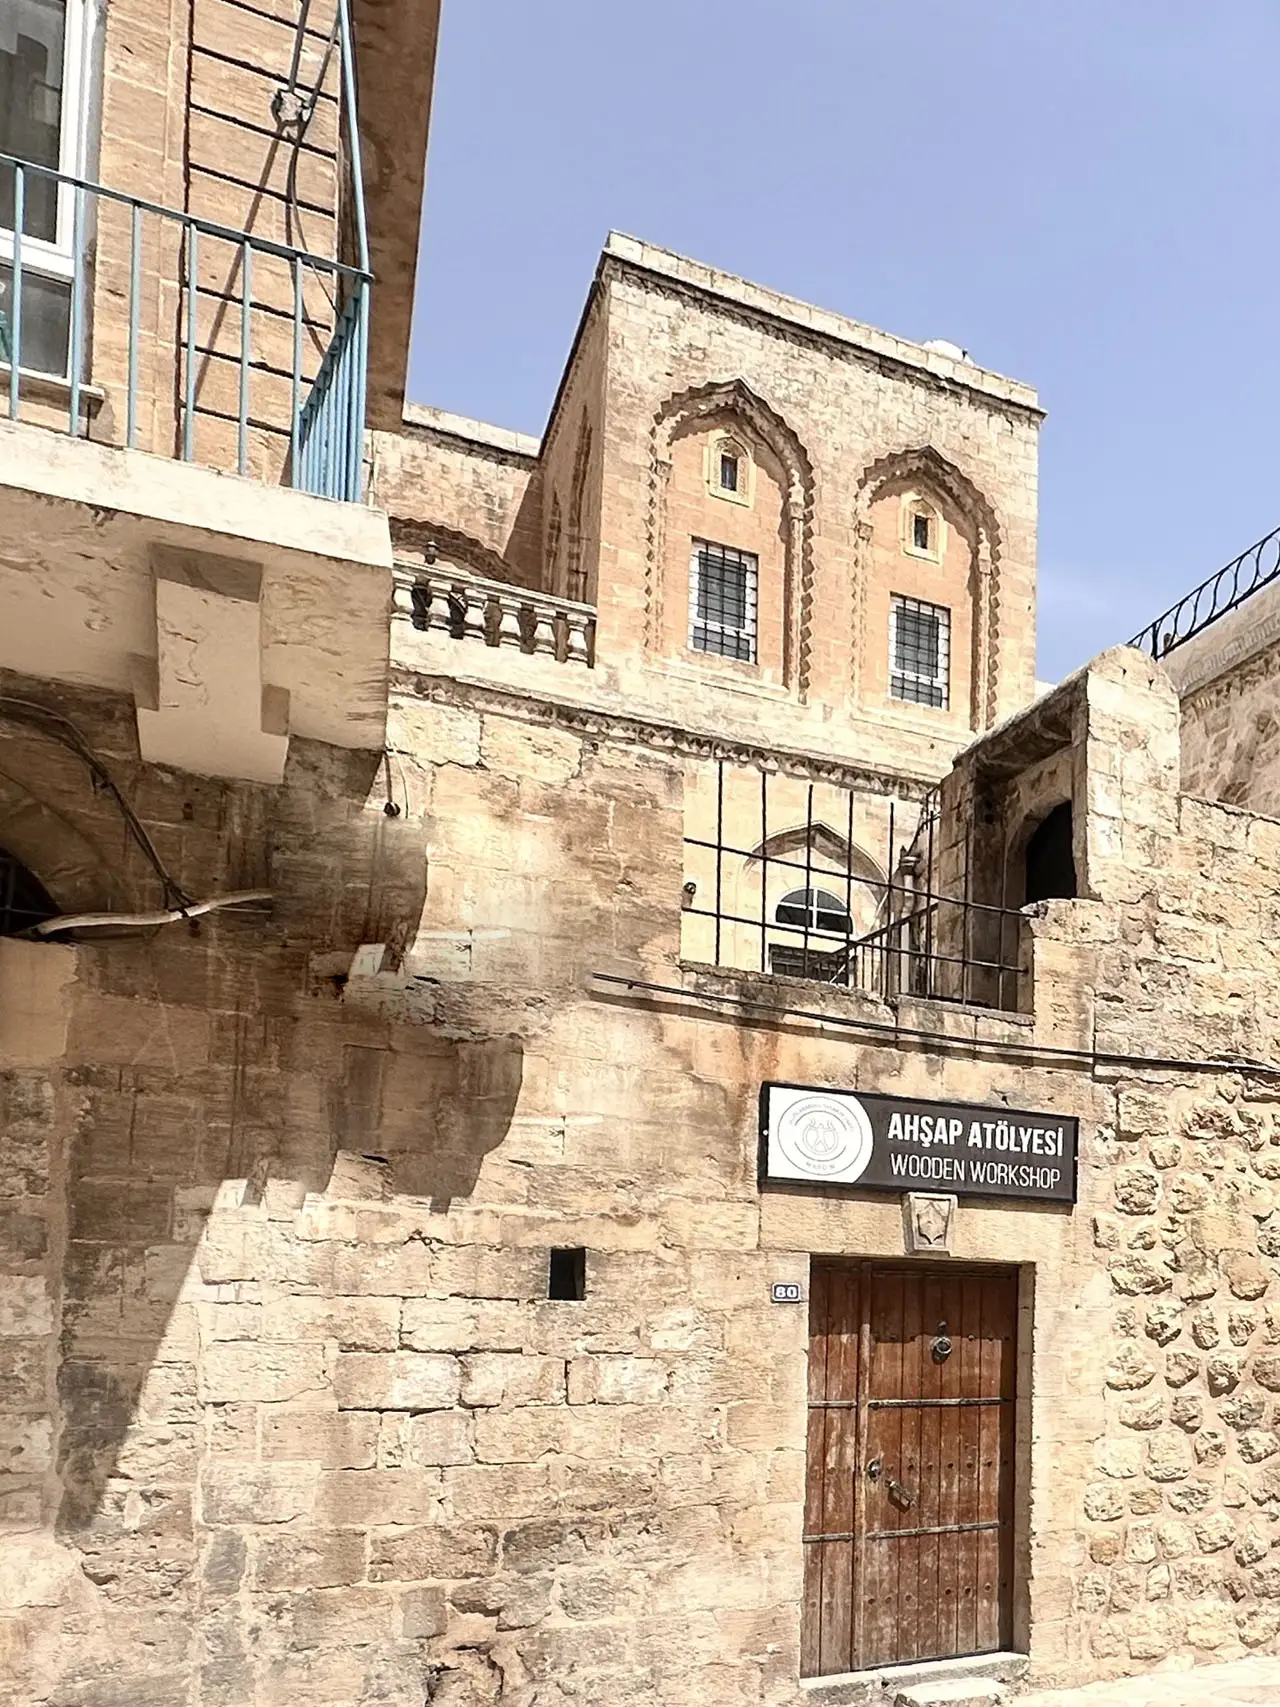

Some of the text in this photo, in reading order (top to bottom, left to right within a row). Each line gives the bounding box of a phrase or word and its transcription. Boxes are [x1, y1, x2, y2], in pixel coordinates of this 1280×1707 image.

[888, 1112, 963, 1147] AHŞAP
[968, 1120, 1063, 1157] ATÖLYESİ
[891, 1153, 1061, 1189] WOODEN WORKSHOP
[775, 1286, 797, 1298] 80
